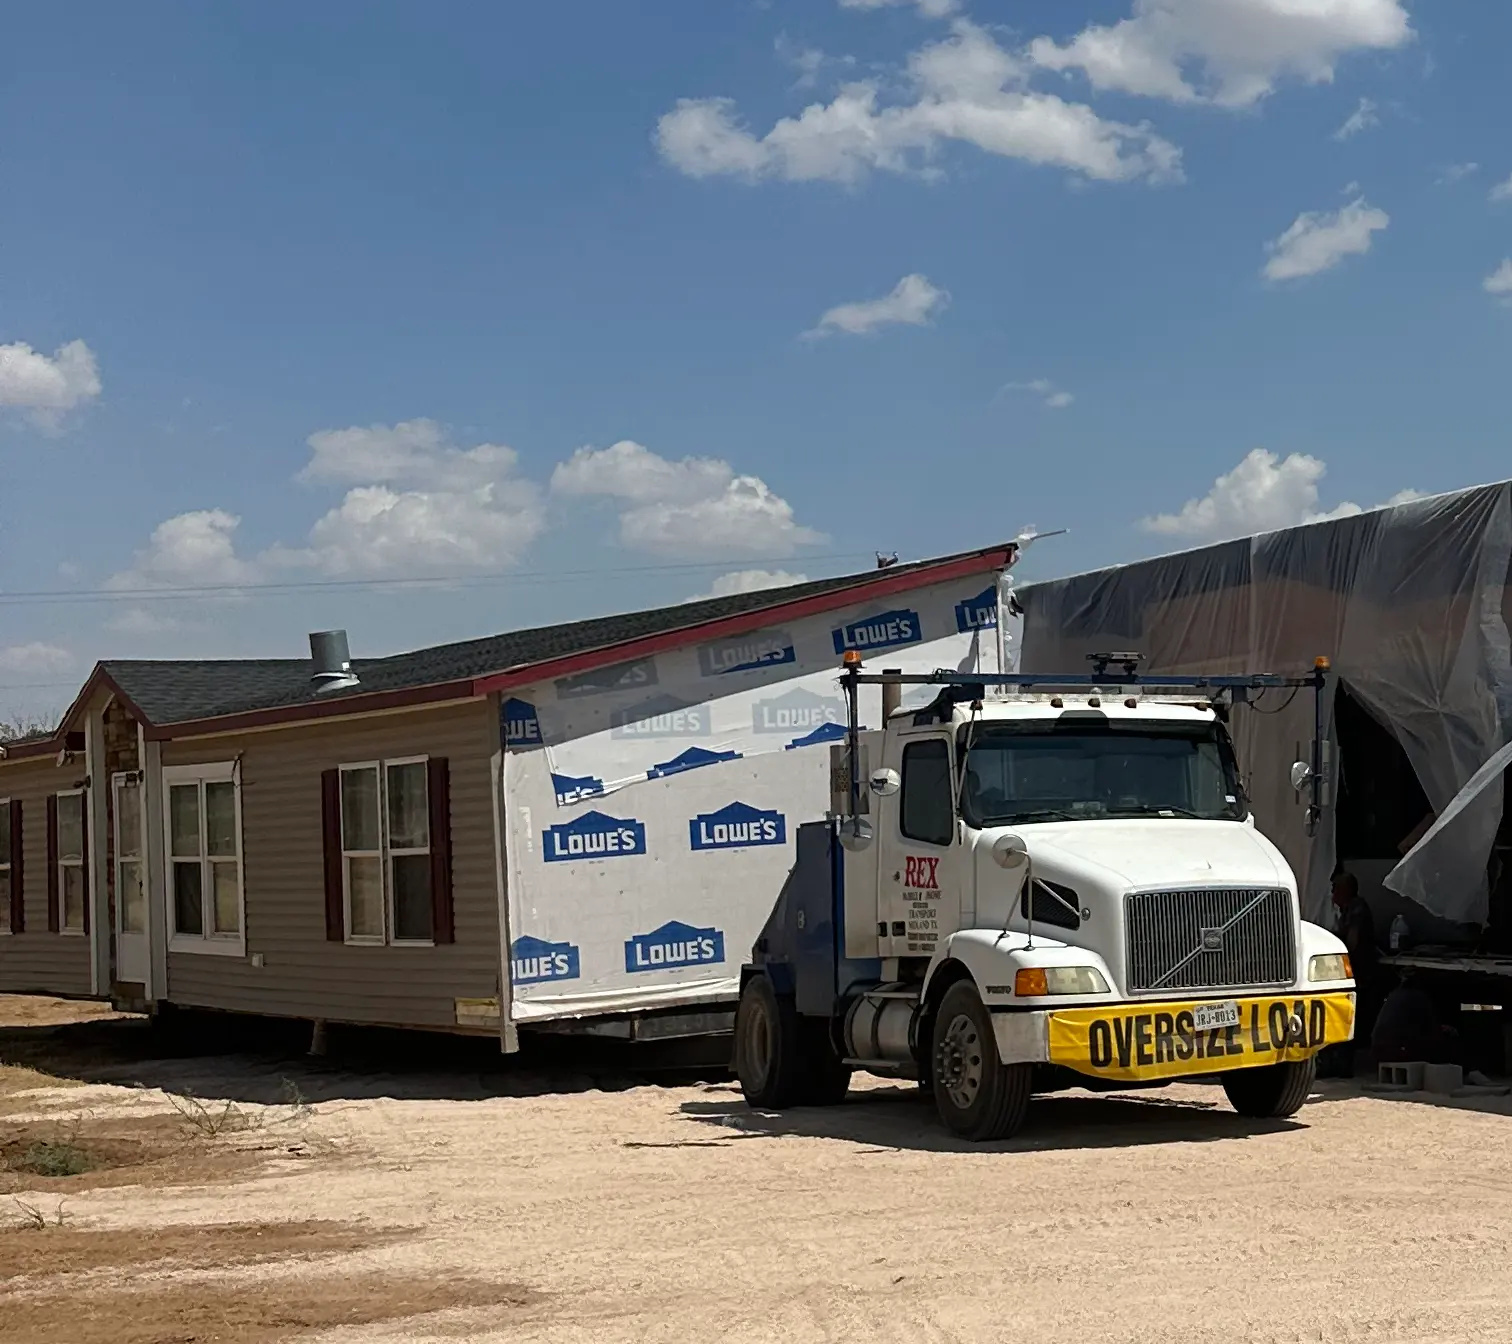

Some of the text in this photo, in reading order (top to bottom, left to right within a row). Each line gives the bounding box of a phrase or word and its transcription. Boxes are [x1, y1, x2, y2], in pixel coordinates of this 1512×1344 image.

[841, 618, 914, 648] LOWE'S
[763, 705, 838, 729] LOWE'S
[554, 827, 637, 856] LOWE'S
[700, 817, 778, 844] LOWE'S
[904, 855, 940, 890] REX
[635, 936, 716, 966] LOWE'S
[1252, 999, 1326, 1052] LOAD
